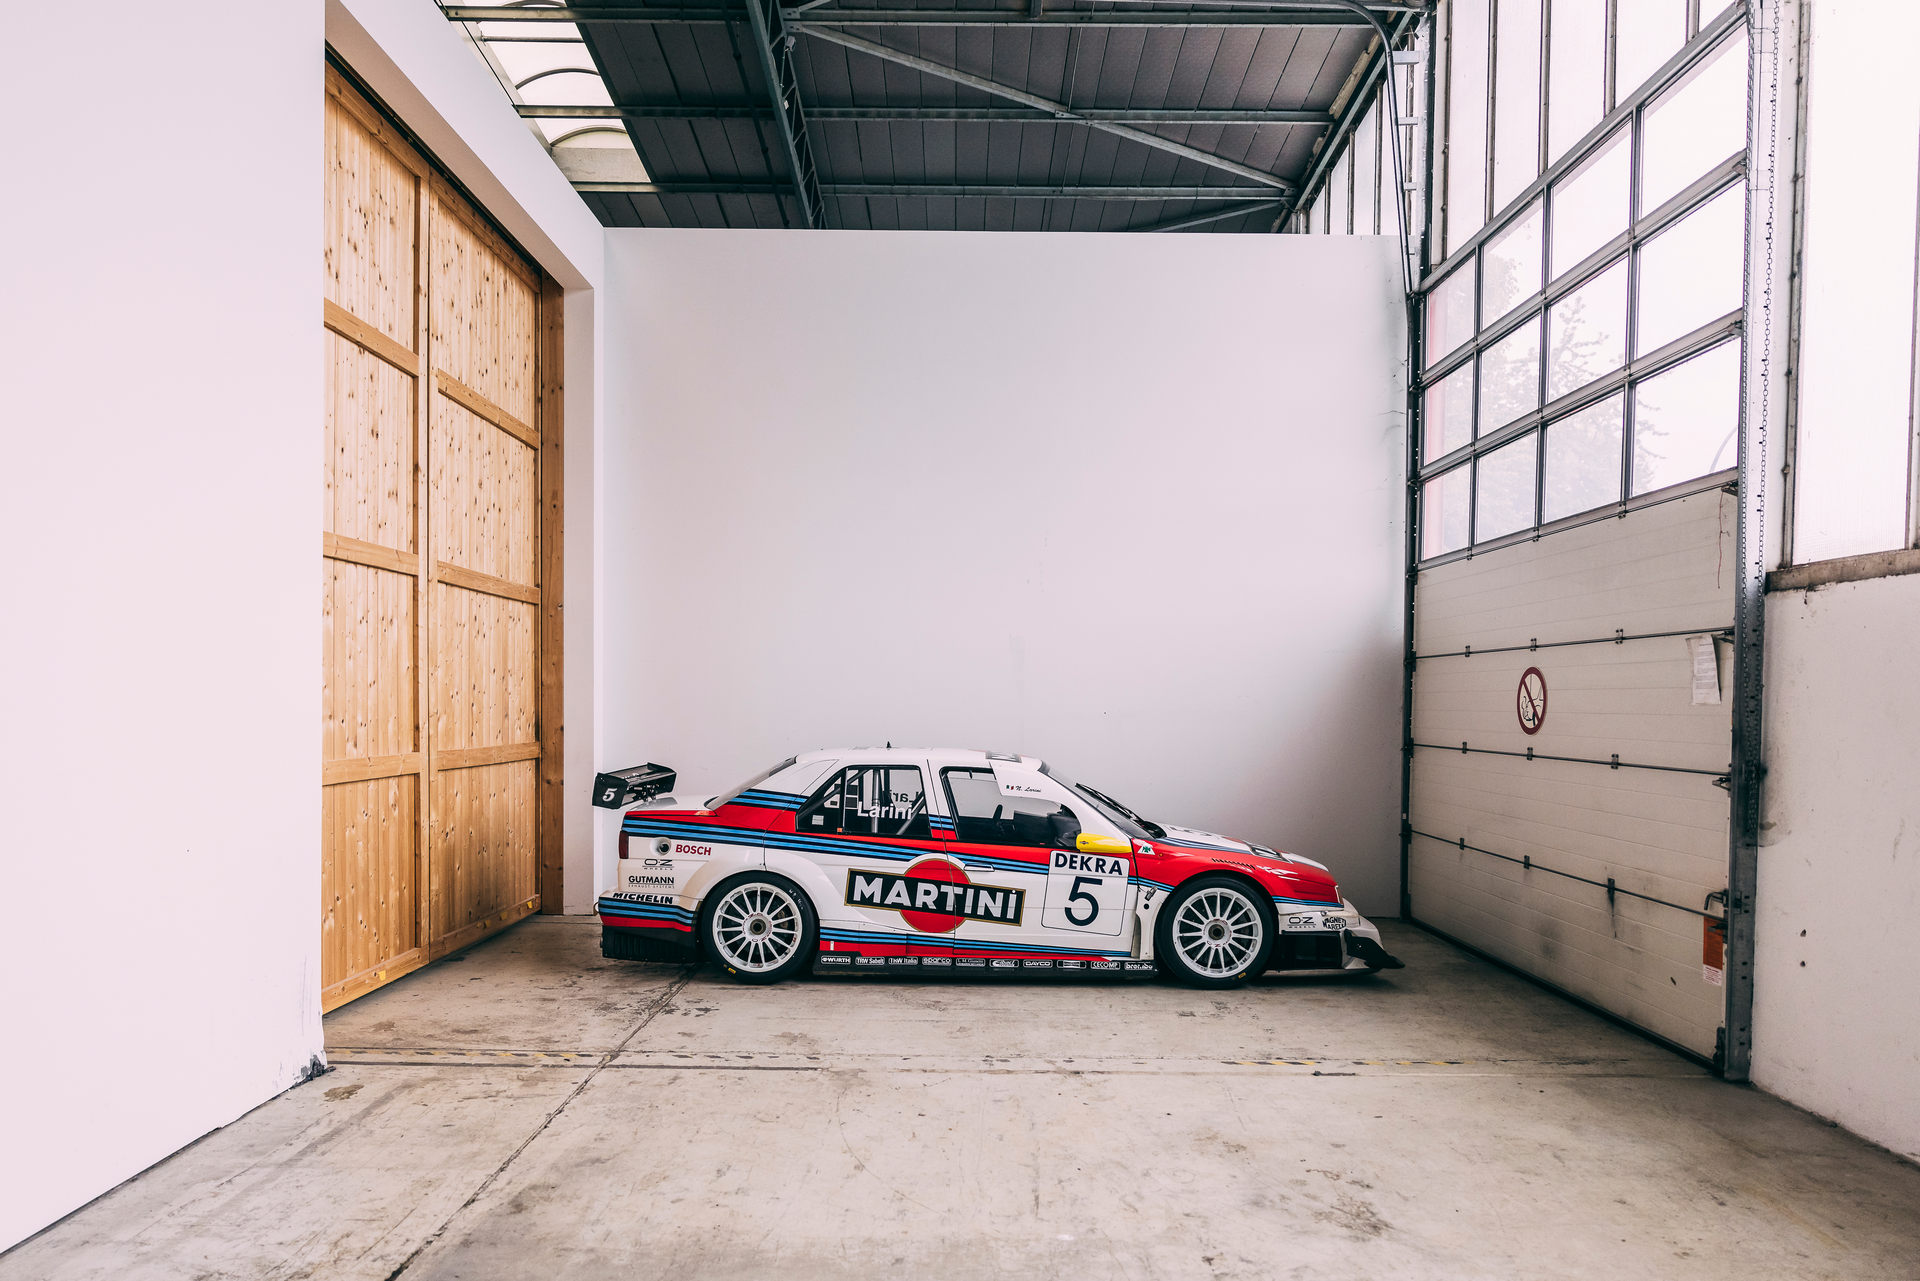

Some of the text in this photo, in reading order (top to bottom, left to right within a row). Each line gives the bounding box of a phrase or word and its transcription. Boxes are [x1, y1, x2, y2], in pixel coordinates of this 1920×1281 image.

[602, 788, 618, 802] 5
[857, 801, 912, 820] Larini
[675, 844, 711, 856] BOSCH
[1054, 852, 1123, 876] DEKRA
[628, 876, 674, 884] GUTMANN
[612, 893, 673, 904] MICHELIN
[853, 875, 1017, 919] MARTINI
[1064, 875, 1103, 927] 5
